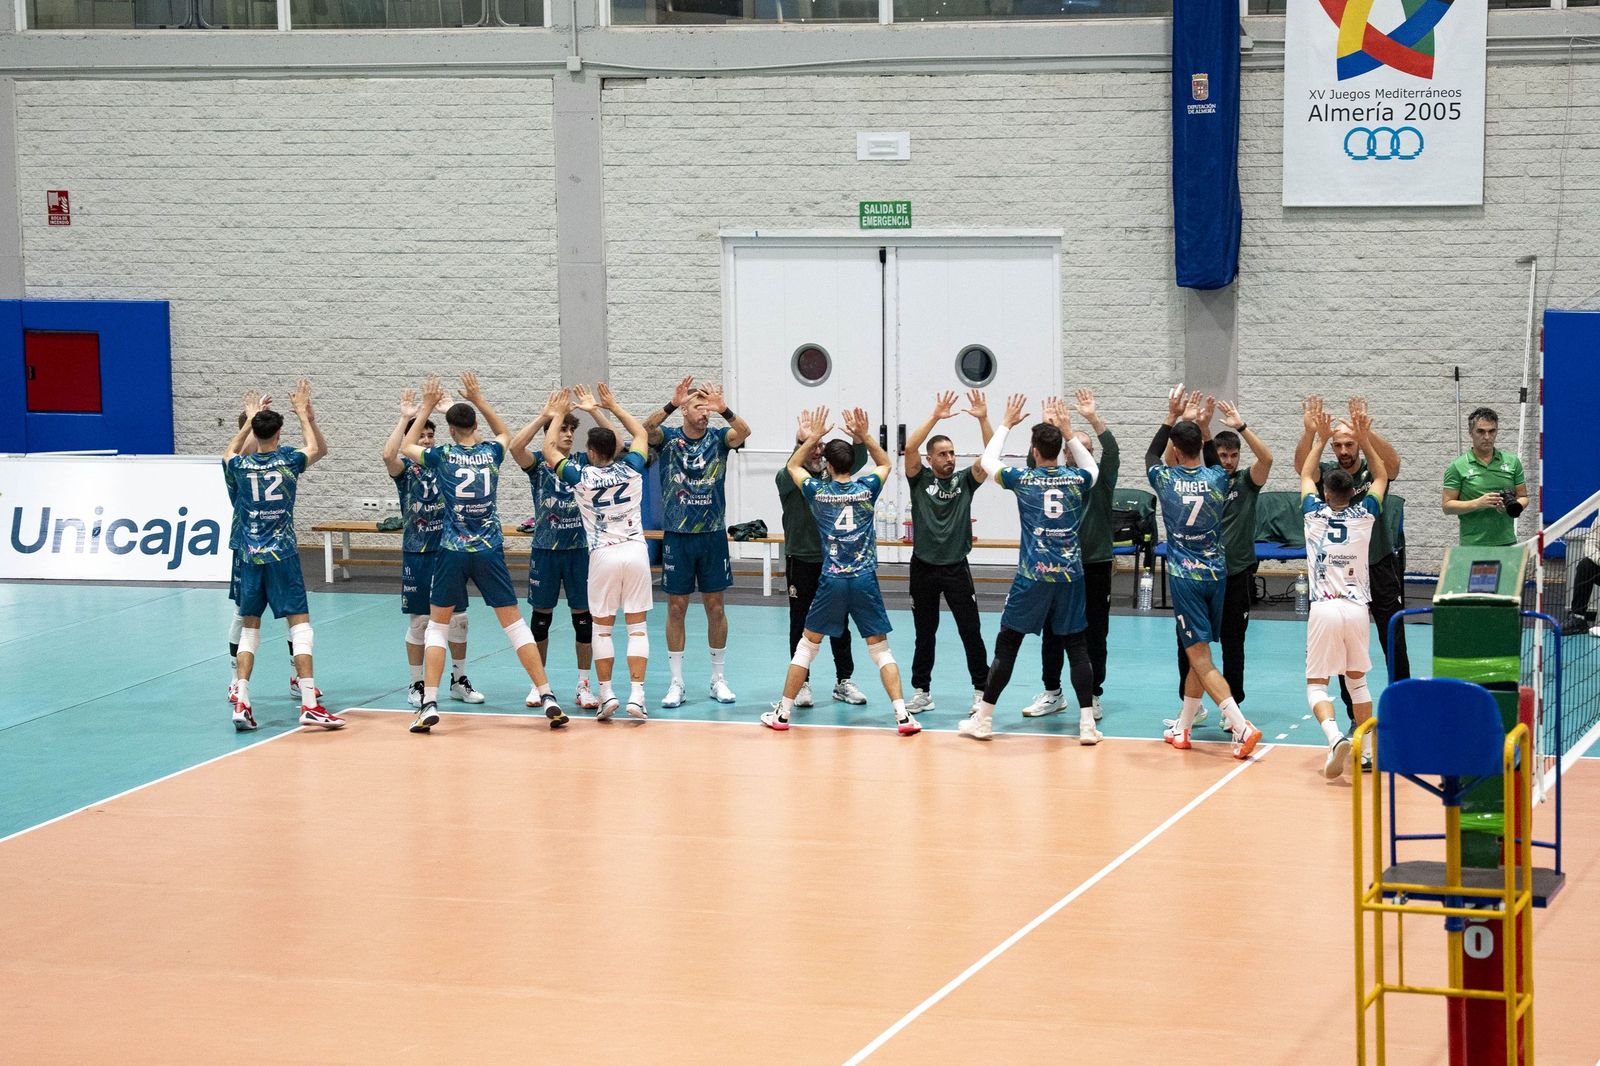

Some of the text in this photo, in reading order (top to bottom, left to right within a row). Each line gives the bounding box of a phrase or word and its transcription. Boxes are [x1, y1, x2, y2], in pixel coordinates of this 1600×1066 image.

[1309, 87, 1462, 101] XV Juegos Mediterráneos
[1308, 102, 1462, 122] Almería 2005
[862, 215, 910, 227] EMERGENCIA
[864, 203, 908, 215] SALIDA DE
[246, 470, 284, 502] 12
[455, 467, 492, 498] 21
[590, 482, 631, 508] 22
[1043, 489, 1064, 519] 6
[1182, 496, 1204, 527] 7
[834, 505, 858, 533] 4
[1327, 518, 1349, 543] 5
[10, 506, 221, 570] Unicaja
[1328, 553, 1358, 561] Fundación
